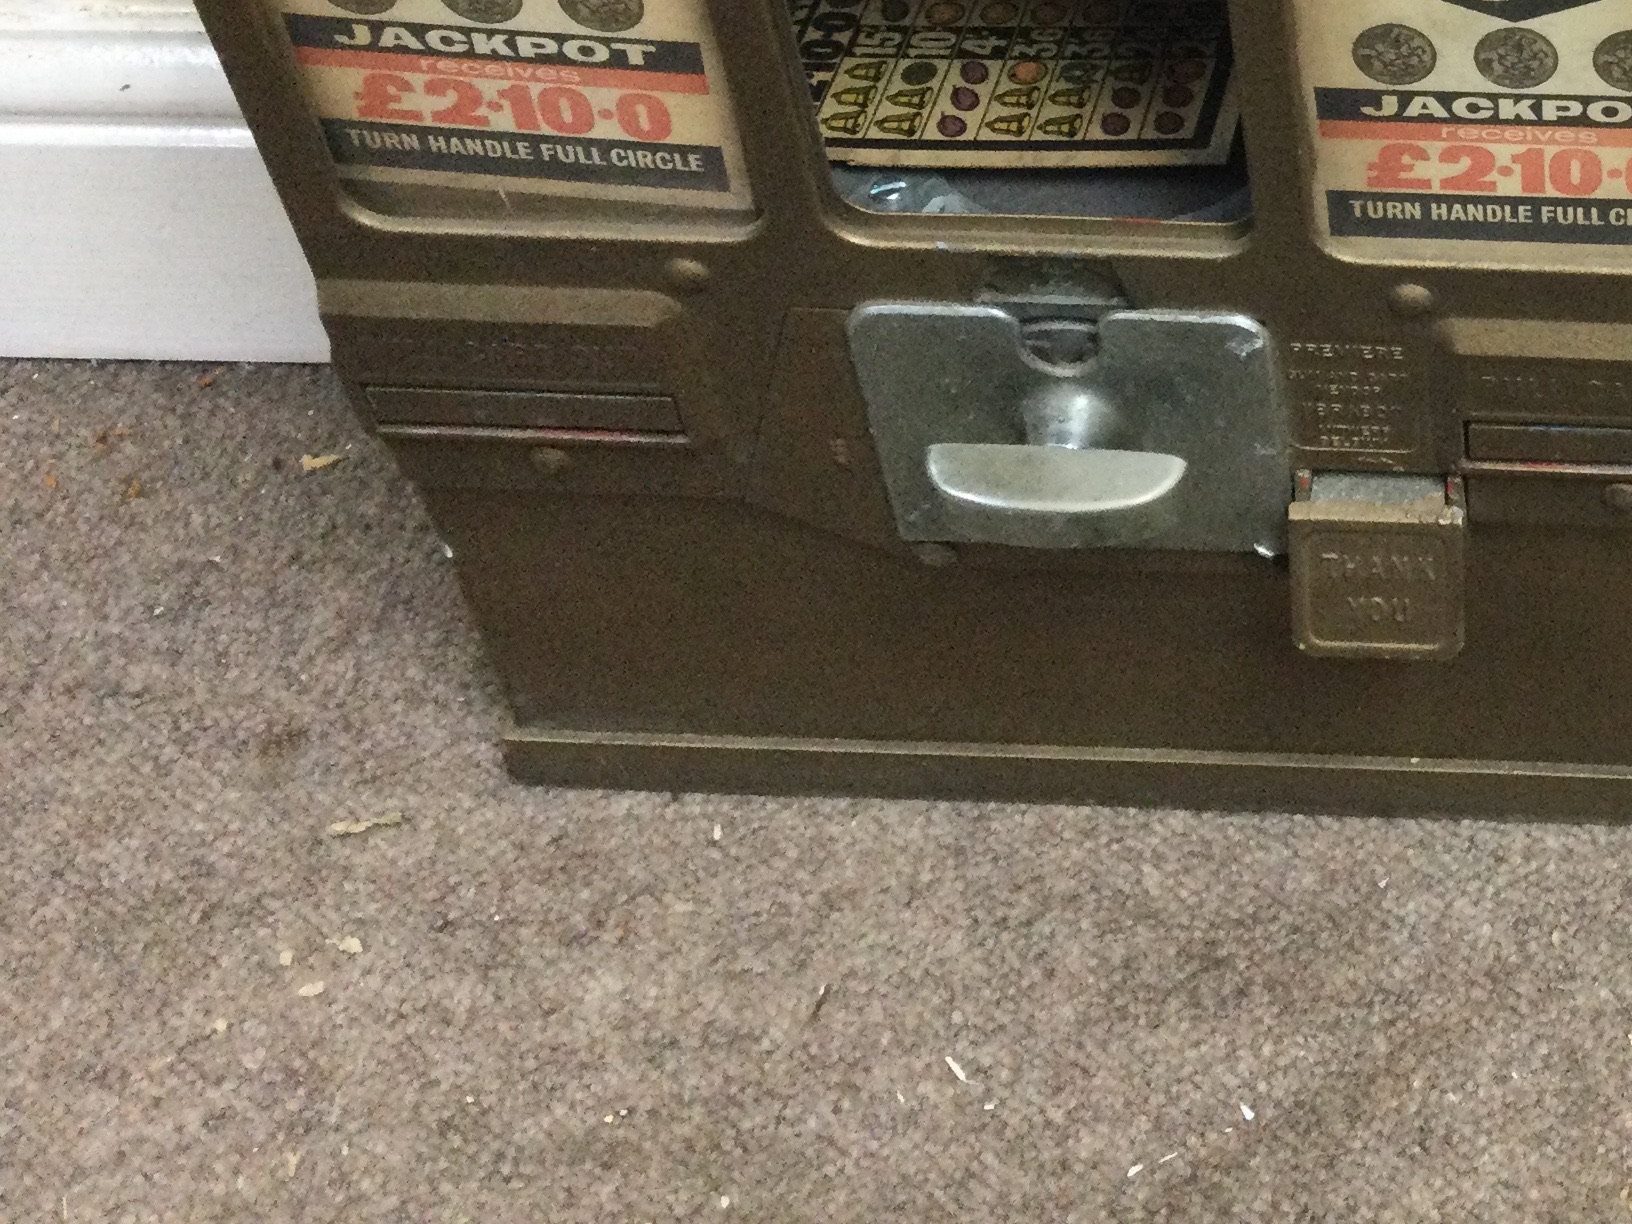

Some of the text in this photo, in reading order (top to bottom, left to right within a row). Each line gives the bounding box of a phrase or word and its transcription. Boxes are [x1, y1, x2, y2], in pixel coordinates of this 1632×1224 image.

[334, 21, 657, 67] JACKPOT
[418, 55, 582, 85] receives
[1440, 125, 1599, 144] receives
[347, 128, 706, 173] TURN HANDLE FULL CIRCLE
[1349, 199, 1422, 221] TURN
[1431, 203, 1533, 224] HANDLE
[1541, 205, 1605, 226] FULL
